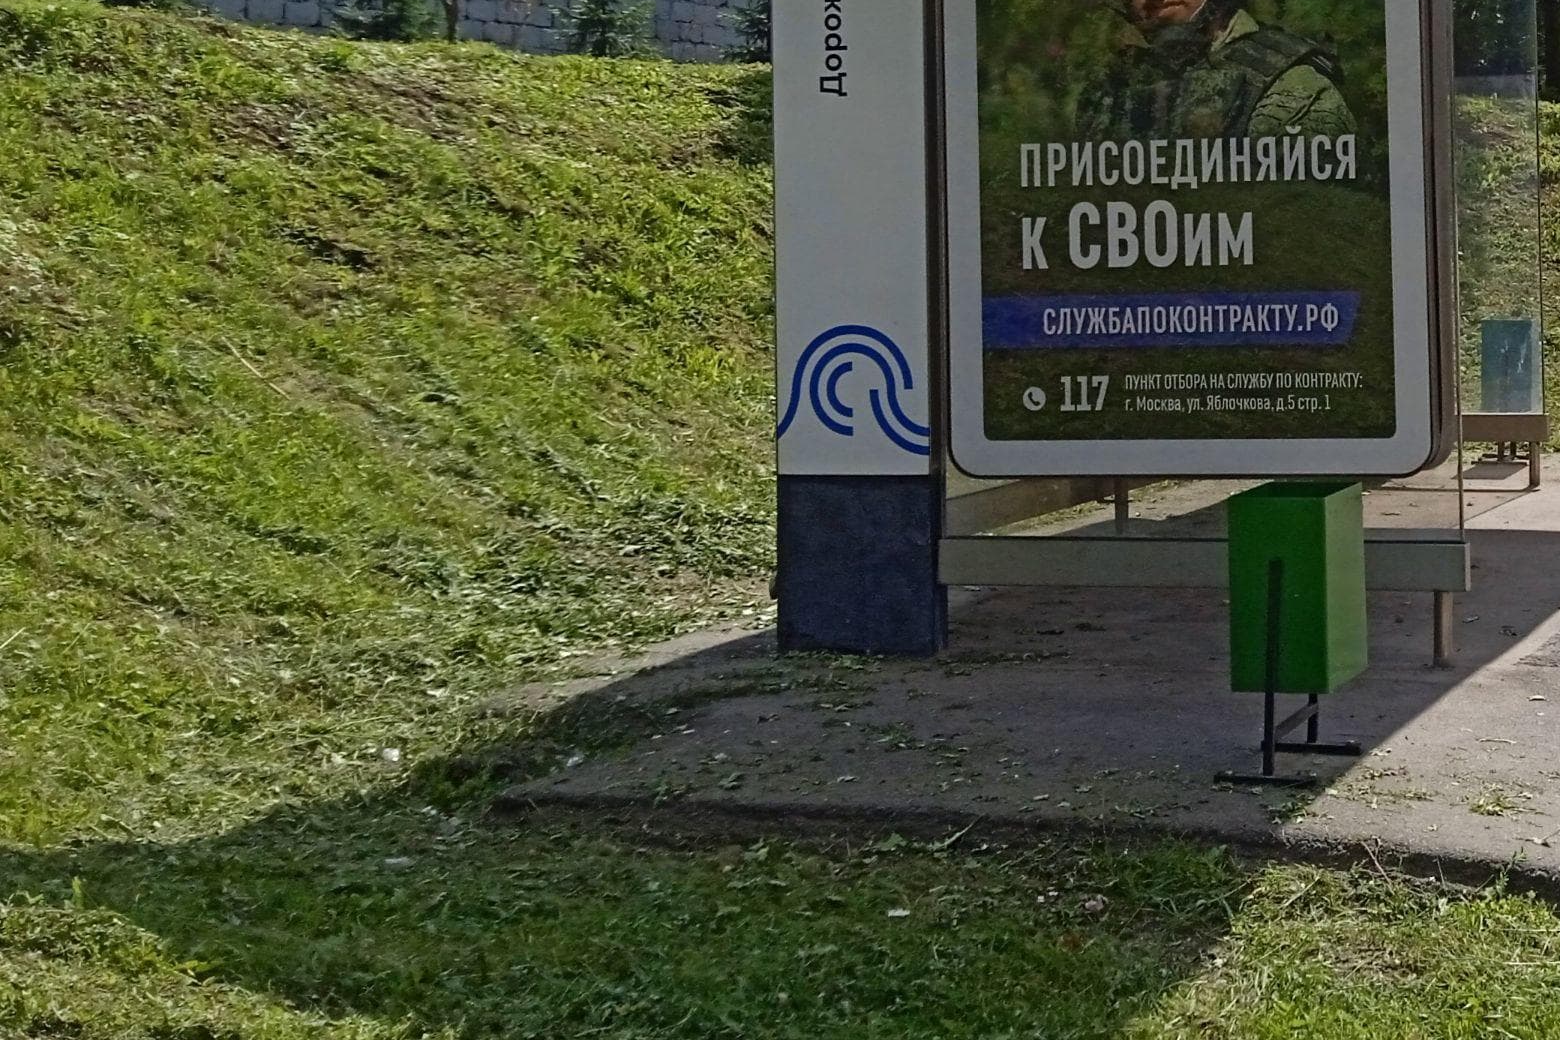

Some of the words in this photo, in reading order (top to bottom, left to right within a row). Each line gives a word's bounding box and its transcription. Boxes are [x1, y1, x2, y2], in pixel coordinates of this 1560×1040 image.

[1020, 125, 1357, 190] ПРИСОЕДИНЯЙСЯ
[1043, 302, 1339, 336] СЛУЖБАПОКОНТРАКТУ.РФ
[1060, 375, 1110, 412] 117
[1125, 374, 1162, 390] ПУНКТ
[1164, 373, 1208, 390] ОТБОРА
[1210, 373, 1226, 389] НА
[1227, 372, 1274, 389] СЛУЖБУ
[1276, 372, 1292, 389] ПО
[1295, 372, 1363, 389] КОНТРАКТУ:
[1125, 399, 1134, 411] г.
[1136, 395, 1185, 412] Москва,
[1186, 398, 1204, 414] ул.
[1206, 395, 1274, 412] Яблочкова,
[1297, 397, 1322, 413] стр.
[1325, 394, 1331, 410] 1
